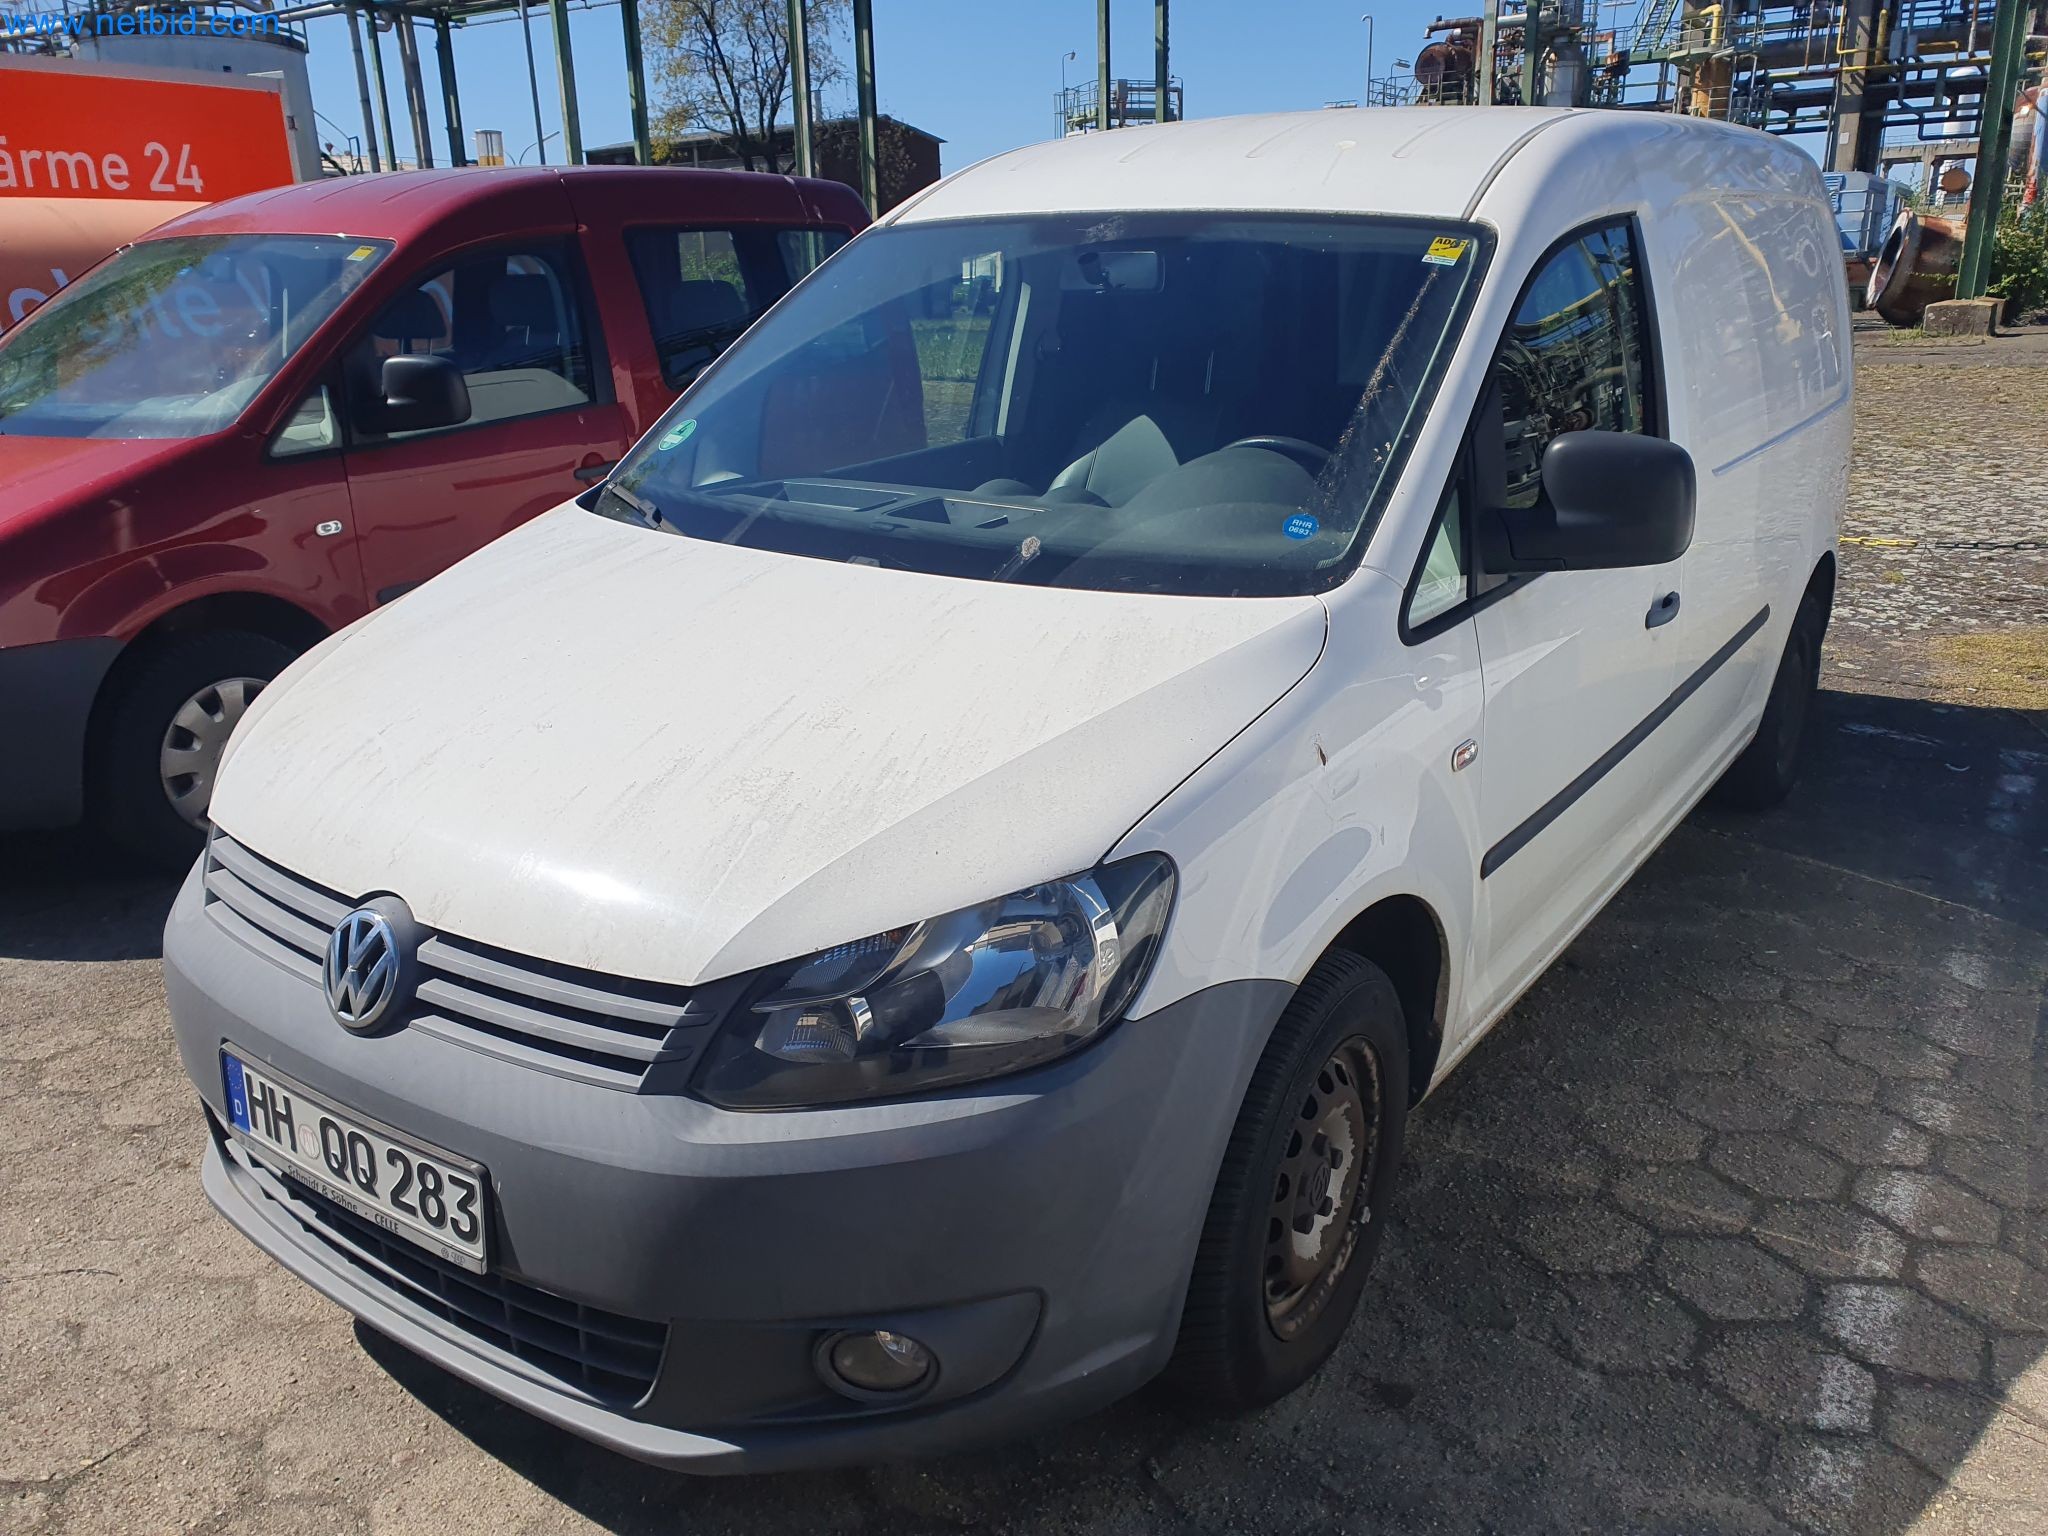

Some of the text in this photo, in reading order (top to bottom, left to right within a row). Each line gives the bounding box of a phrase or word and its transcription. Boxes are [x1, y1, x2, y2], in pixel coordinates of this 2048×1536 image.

[143, 141, 204, 193] 24
[234, 1098, 242, 1116] D
[244, 1071, 478, 1243] HH QQ 283
[288, 1164, 319, 1191] Schmidt
[331, 1190, 358, 1213] Söhne
[374, 1213, 399, 1234] CELLE
